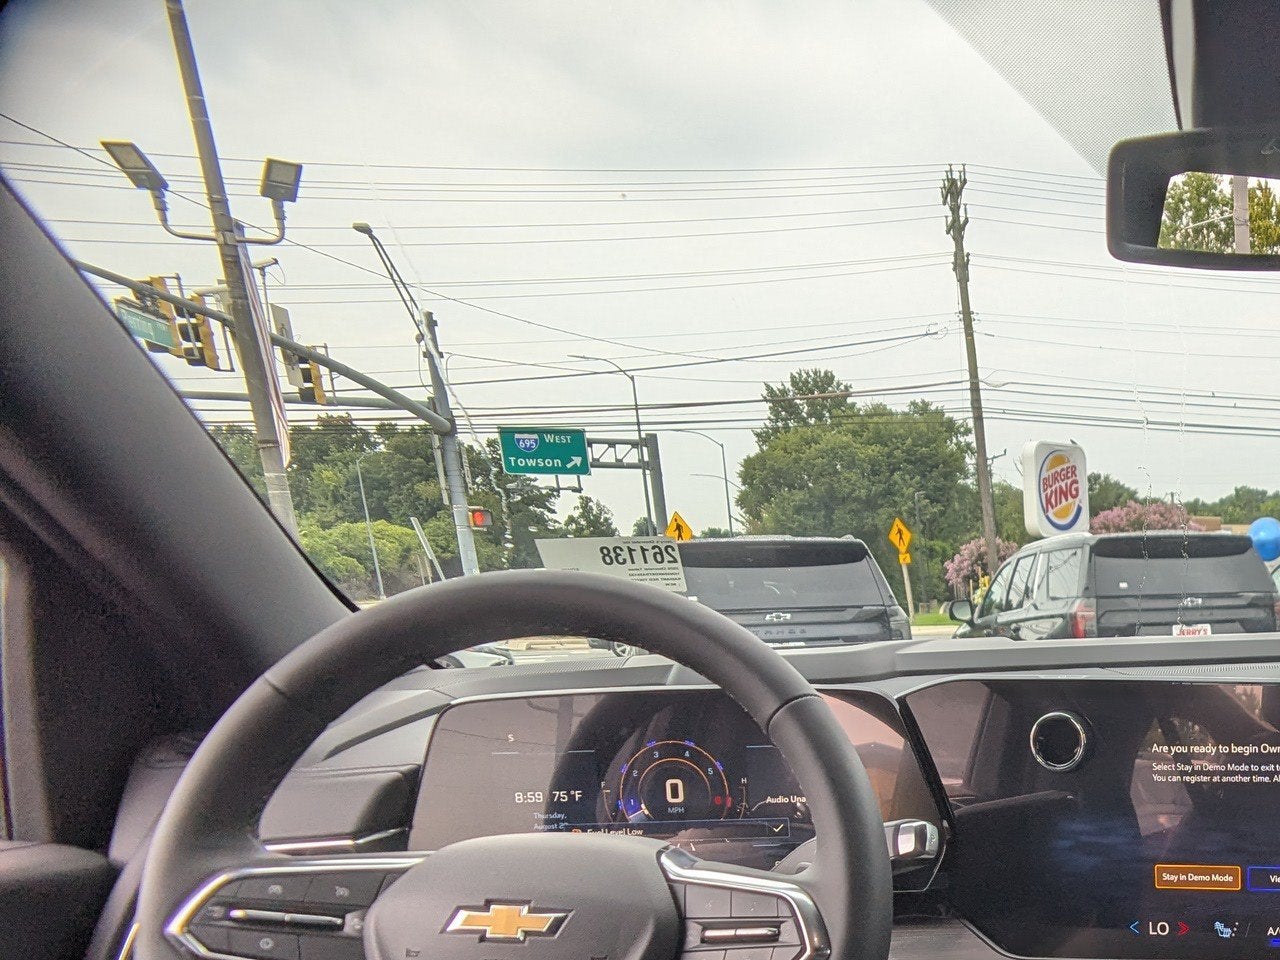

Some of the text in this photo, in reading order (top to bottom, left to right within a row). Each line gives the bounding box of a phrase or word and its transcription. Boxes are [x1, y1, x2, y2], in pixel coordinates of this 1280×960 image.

[519, 434, 571, 449] 695 WEST
[509, 457, 562, 467] Towson
[1042, 464, 1077, 493] BURGER
[1044, 478, 1079, 514] KING
[1152, 743, 1168, 753] Are
[1170, 745, 1188, 755] you
[1190, 743, 1217, 755] ready
[1219, 744, 1229, 753] to
[1231, 743, 1258, 756] begin
[1152, 763, 1175, 771] Select
[1176, 763, 1193, 772] Stay
[1194, 763, 1201, 771] in
[1203, 763, 1226, 771] Demo
[1227, 763, 1249, 772] Mode
[1251, 764, 1259, 772] to
[1261, 764, 1274, 772] exit
[1152, 774, 1166, 782] You
[1183, 774, 1210, 783] register
[1221, 774, 1251, 782] another
[1252, 775, 1271, 783] time.
[665, 778, 685, 803] 0
[514, 791, 543, 803] 8:59
[552, 791, 568, 802] 75
[533, 823, 557, 831] August
[605, 828, 626, 836] Level
[1162, 872, 1234, 883] Stay in Demo Mode
[1149, 921, 1170, 936] LO
